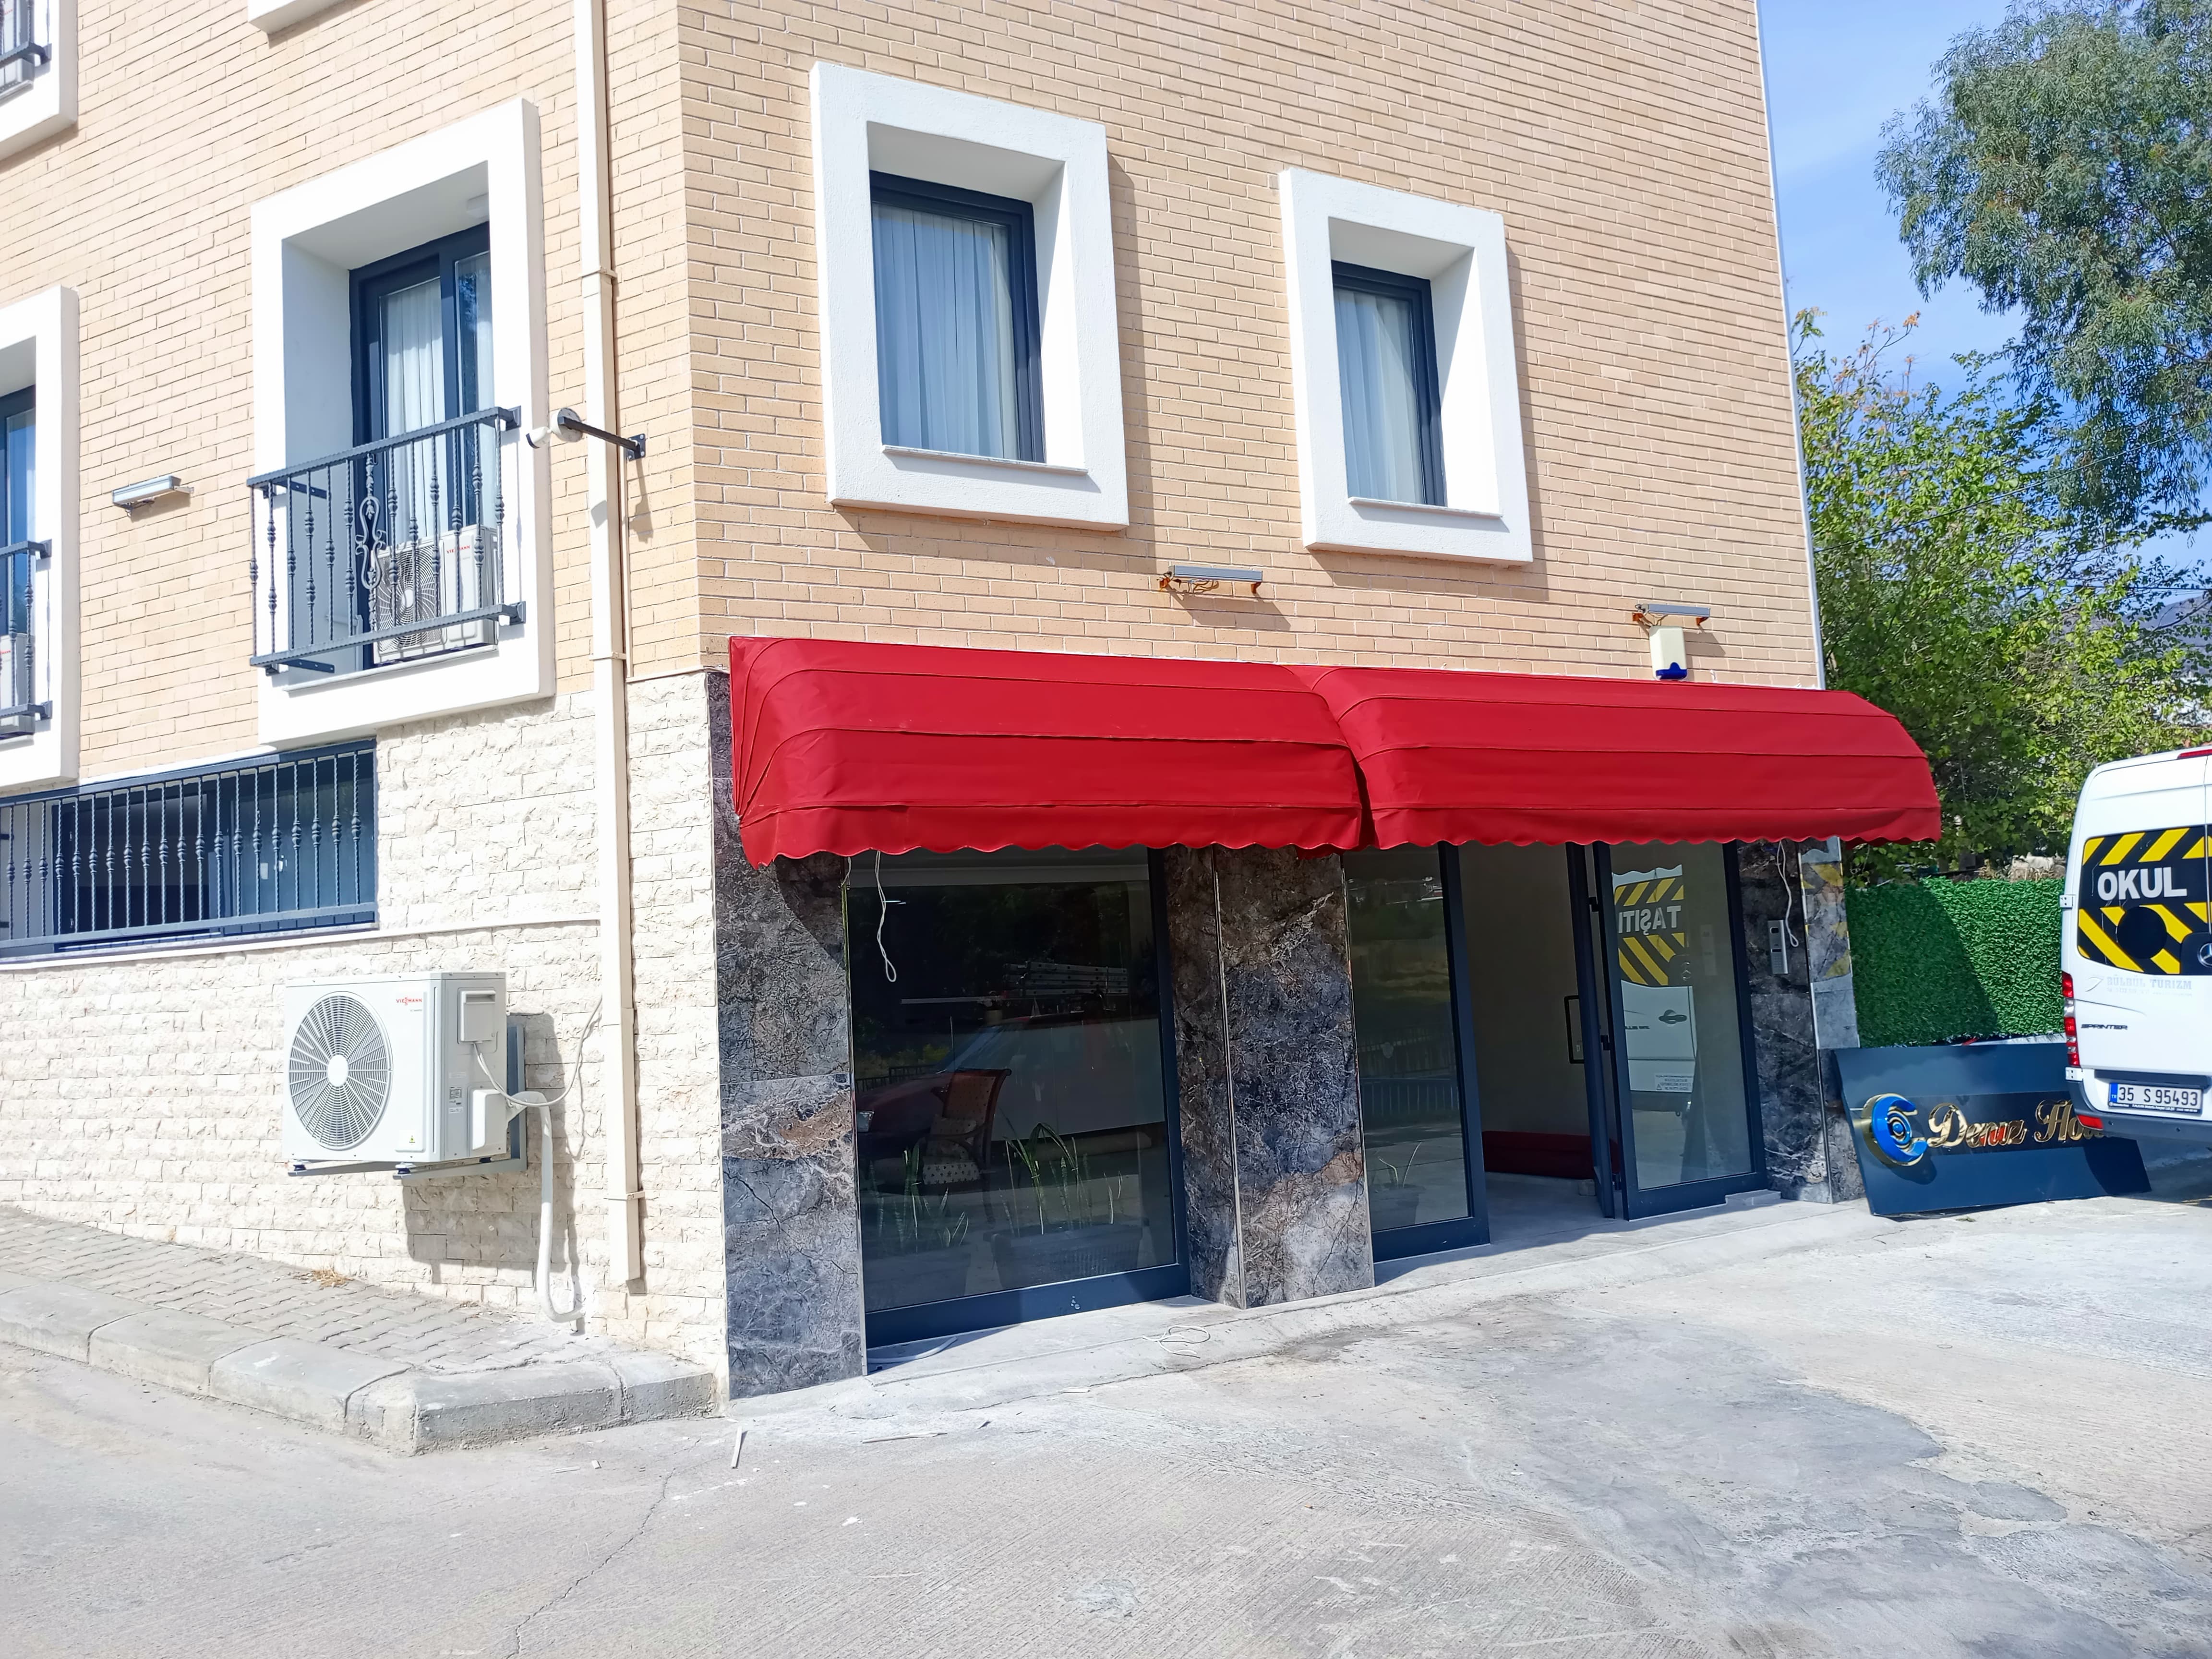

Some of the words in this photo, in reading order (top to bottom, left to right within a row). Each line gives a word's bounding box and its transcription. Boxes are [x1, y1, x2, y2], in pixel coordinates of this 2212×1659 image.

[2097, 867, 2187, 901] OKUL
[2119, 1087, 2134, 1101] 35
[2143, 1088, 2151, 1103] S
[2155, 1089, 2198, 1106] 95493
